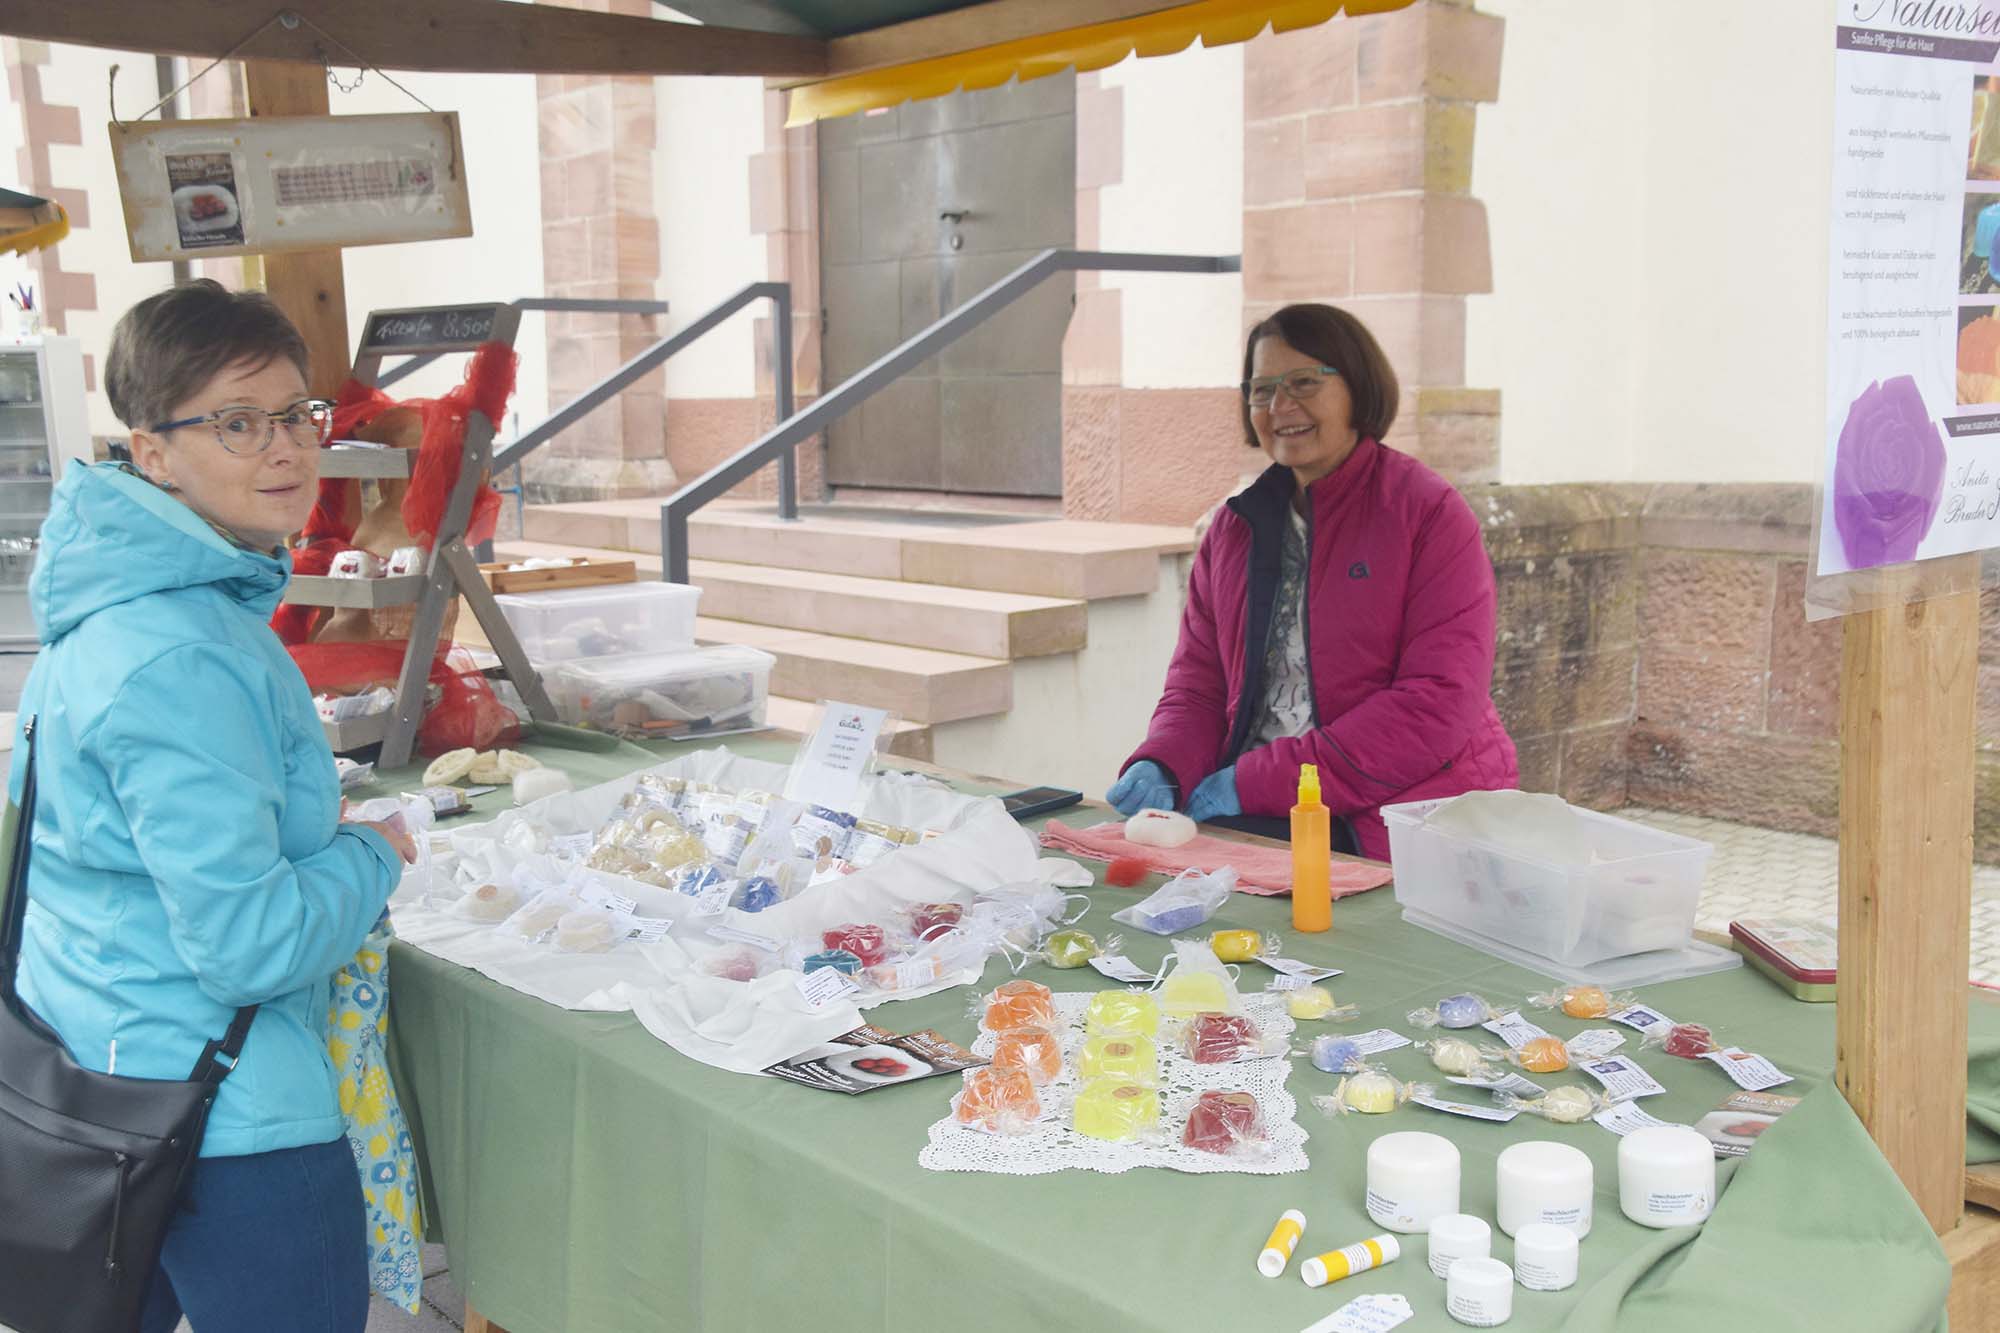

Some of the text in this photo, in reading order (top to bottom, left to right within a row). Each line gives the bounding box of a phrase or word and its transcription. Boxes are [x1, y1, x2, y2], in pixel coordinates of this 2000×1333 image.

[1851, 31, 1935, 52] Sanfte Pflege für die Haut
